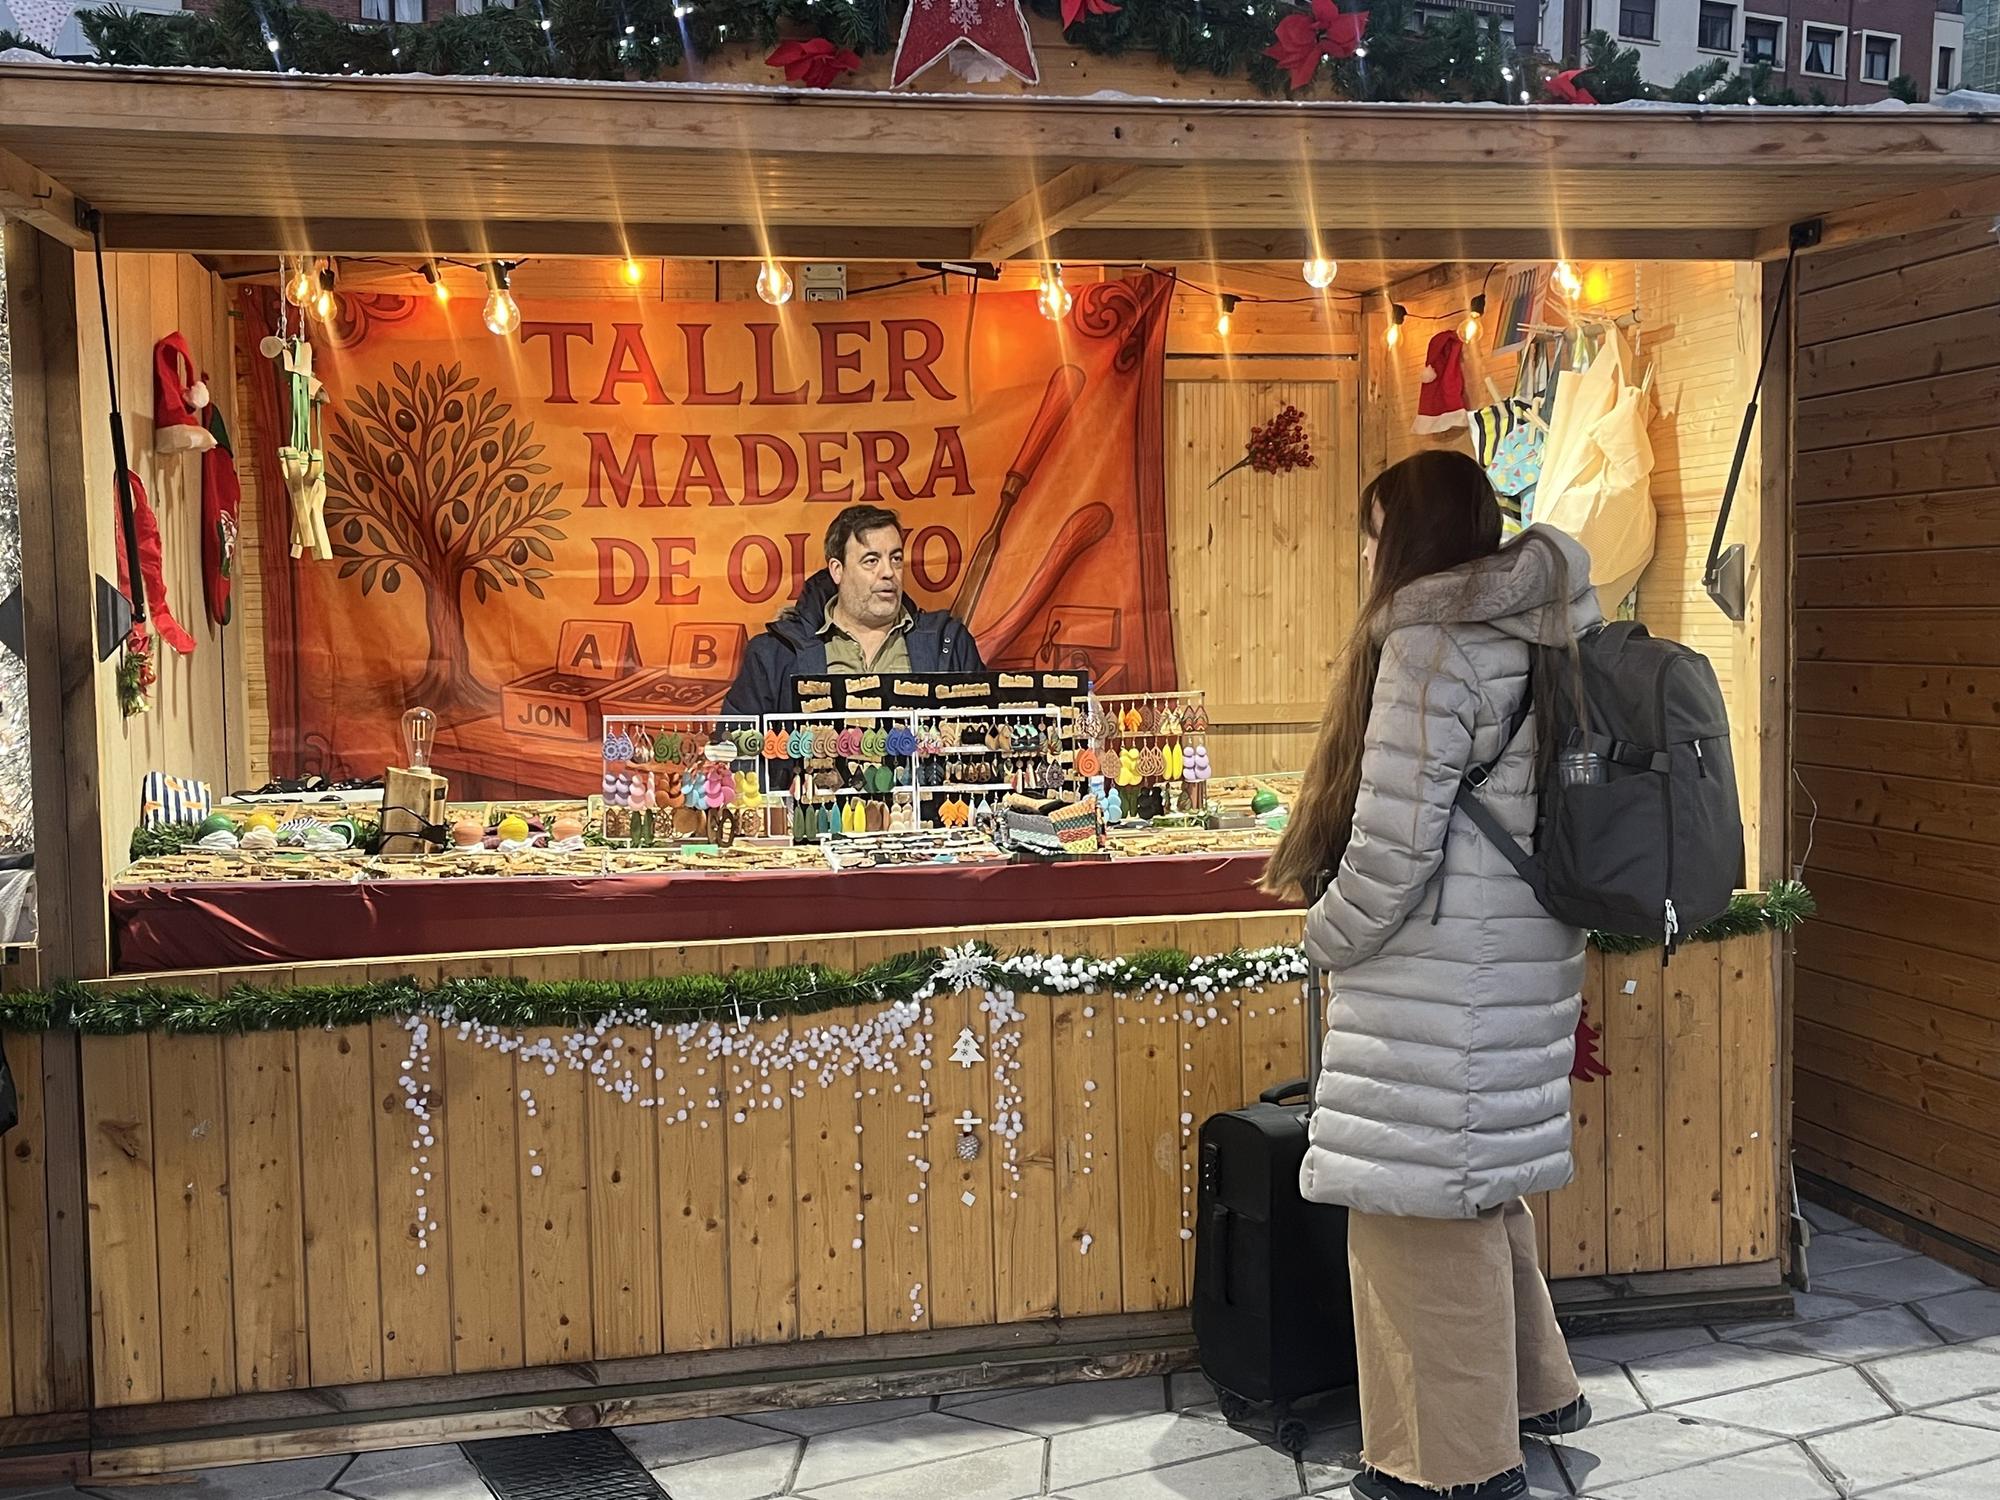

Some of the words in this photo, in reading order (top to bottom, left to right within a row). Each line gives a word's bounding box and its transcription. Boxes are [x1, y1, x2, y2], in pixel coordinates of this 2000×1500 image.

[520, 319, 958, 405] TALLER
[581, 426, 976, 508] MADERA
[591, 537, 701, 605] DE
[570, 634, 603, 670] A
[689, 634, 718, 669] B
[518, 703, 572, 728] JON
